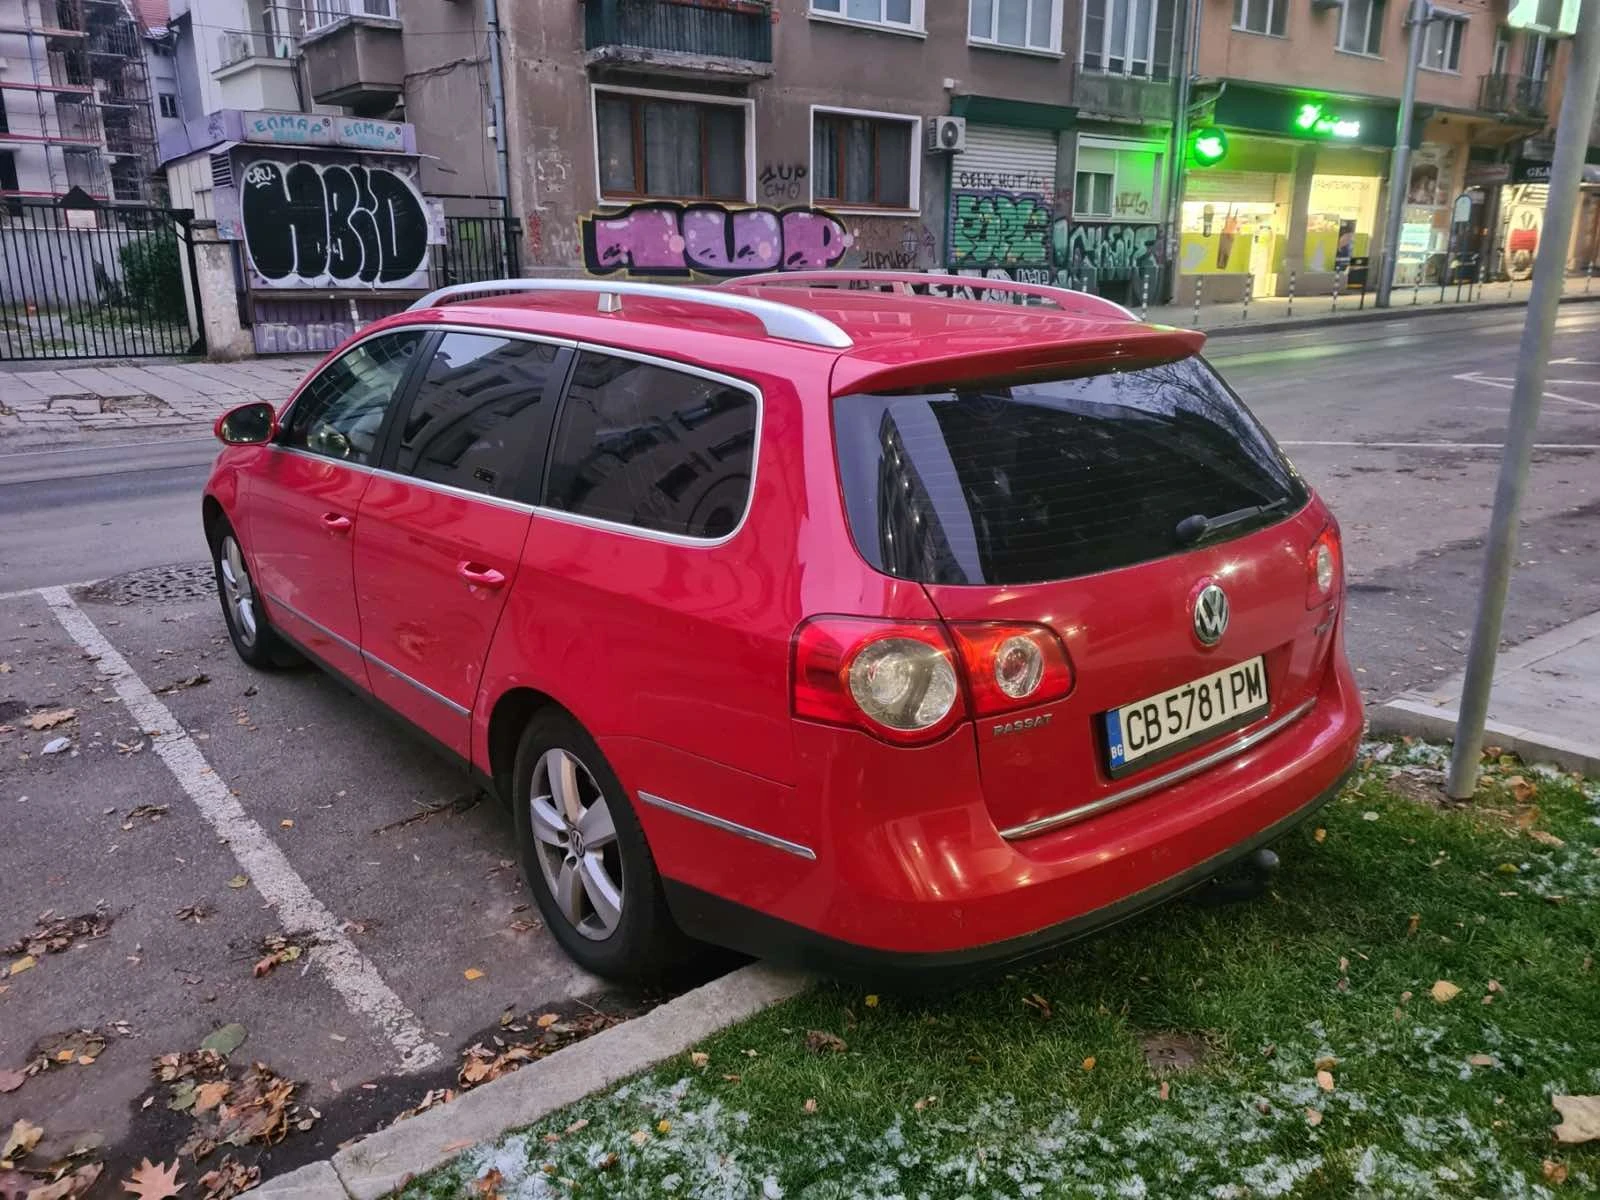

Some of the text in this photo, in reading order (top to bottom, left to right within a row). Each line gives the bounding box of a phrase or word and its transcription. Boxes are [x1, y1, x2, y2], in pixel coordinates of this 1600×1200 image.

[1194, 585, 1229, 645] VW
[993, 713, 1053, 737] PASSAT
[1126, 663, 1263, 751] CB 5781 PM
[1111, 744, 1124, 759] BG
